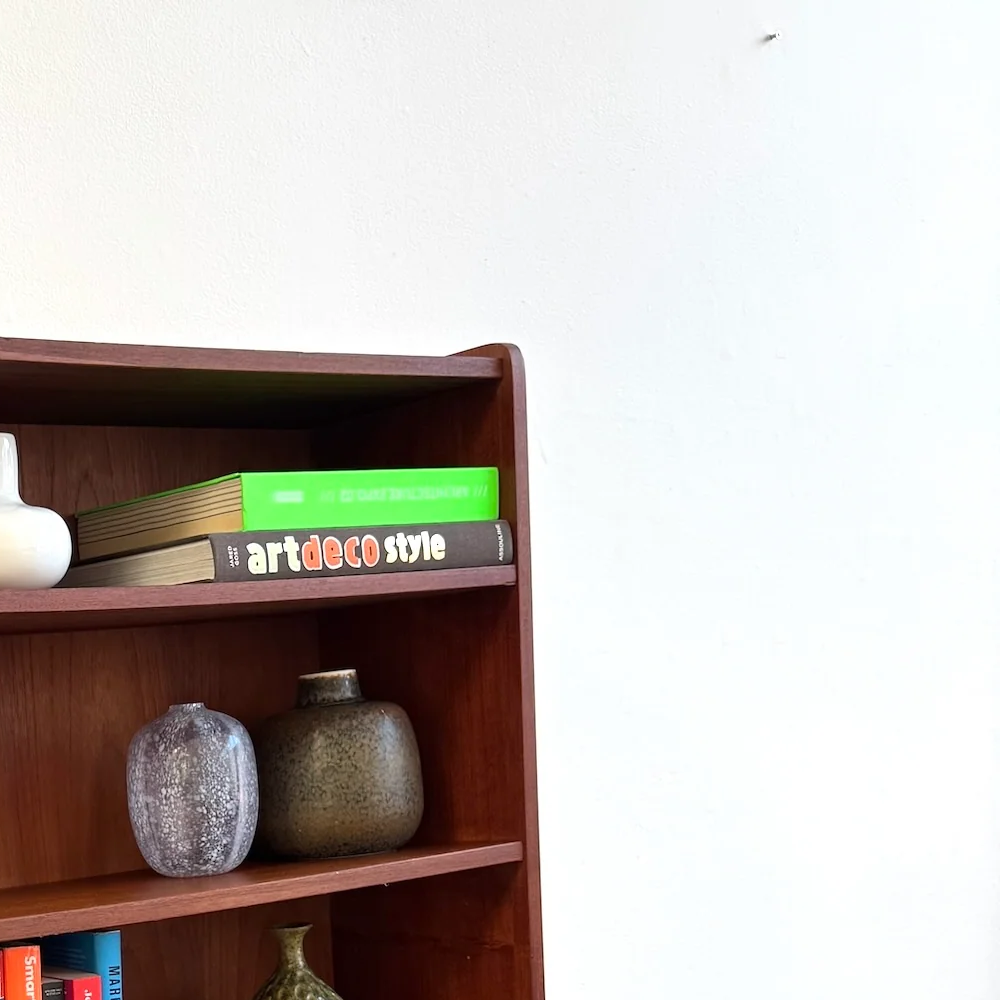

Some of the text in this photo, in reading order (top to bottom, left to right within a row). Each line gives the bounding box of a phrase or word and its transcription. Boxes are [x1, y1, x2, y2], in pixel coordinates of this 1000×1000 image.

[227, 545, 240, 568] JARED GOSS
[384, 530, 446, 565] style
[494, 523, 504, 561] ASSOULINE
